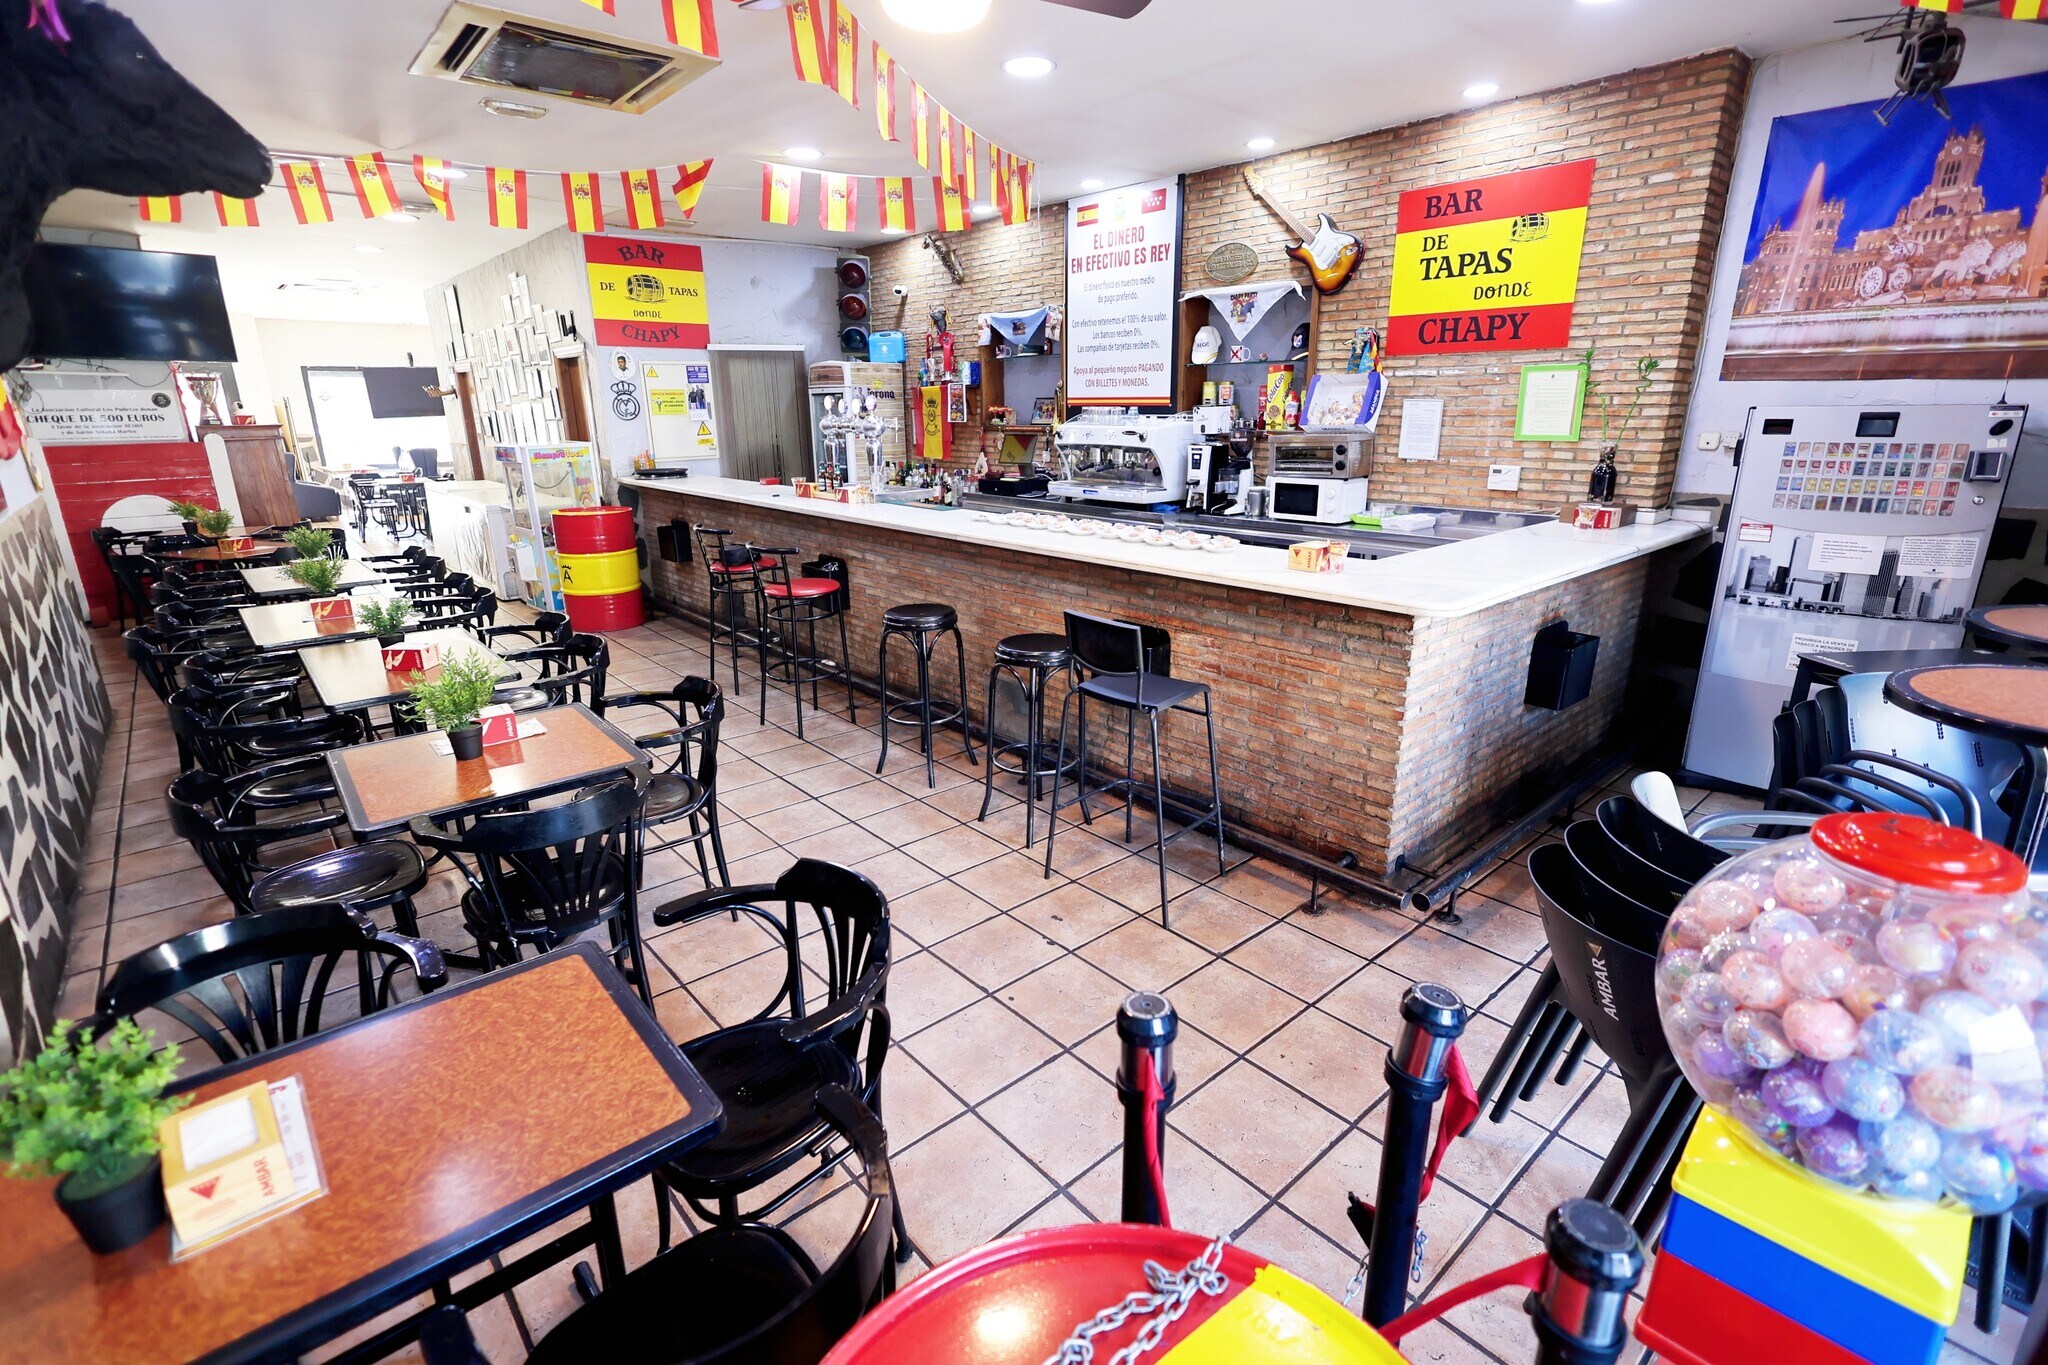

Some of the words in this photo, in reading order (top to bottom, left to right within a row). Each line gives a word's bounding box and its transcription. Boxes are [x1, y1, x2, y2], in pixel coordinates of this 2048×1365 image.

[1424, 188, 1483, 219] BAR
[1094, 234, 1104, 250] EL
[1108, 225, 1145, 248] DINERO
[1422, 234, 1449, 252] DE
[617, 244, 665, 265] BAR
[1072, 257, 1083, 274] EN
[1086, 250, 1130, 272] EFECTIVO
[1134, 247, 1147, 265] ES
[1151, 243, 1171, 262] REY
[1420, 248, 1513, 281] TAPAS
[600, 282, 615, 291] DE
[668, 286, 699, 297] TAPAS
[1104, 294, 1115, 304] pago
[1072, 319, 1080, 328] Con
[1080, 318, 1097, 328] efectivo
[1098, 317, 1121, 326] retenemos
[1122, 315, 1126, 324] el
[1127, 314, 1140, 324] 100%
[1141, 314, 1147, 323] de
[1418, 312, 1531, 345] CHAPY
[621, 324, 680, 342] CHAPY
[1101, 330, 1115, 339] bancos
[1116, 329, 1133, 338] reciben
[1108, 342, 1114, 351] de
[1114, 342, 1132, 352] tarjetas
[1132, 341, 1149, 350] reciben
[1073, 366, 1088, 376] Apoya
[1089, 366, 1093, 374] al
[1094, 365, 1116, 375] pequeño
[1117, 364, 1137, 375] negocio
[1138, 363, 1164, 373] PAGANDO
[1085, 379, 1095, 387] CON
[1096, 378, 1117, 387] BILLETES
[1122, 378, 1149, 387] MONEDAS.
[1266, 373, 1285, 404] ColaCao
[26, 414, 77, 424] CHEQUE
[80, 414, 97, 423] DE
[100, 414, 123, 423] 500
[127, 414, 165, 422] EUROS
[1592, 958, 1619, 1022] AMBAR
[253, 1156, 277, 1197] AMBAR
